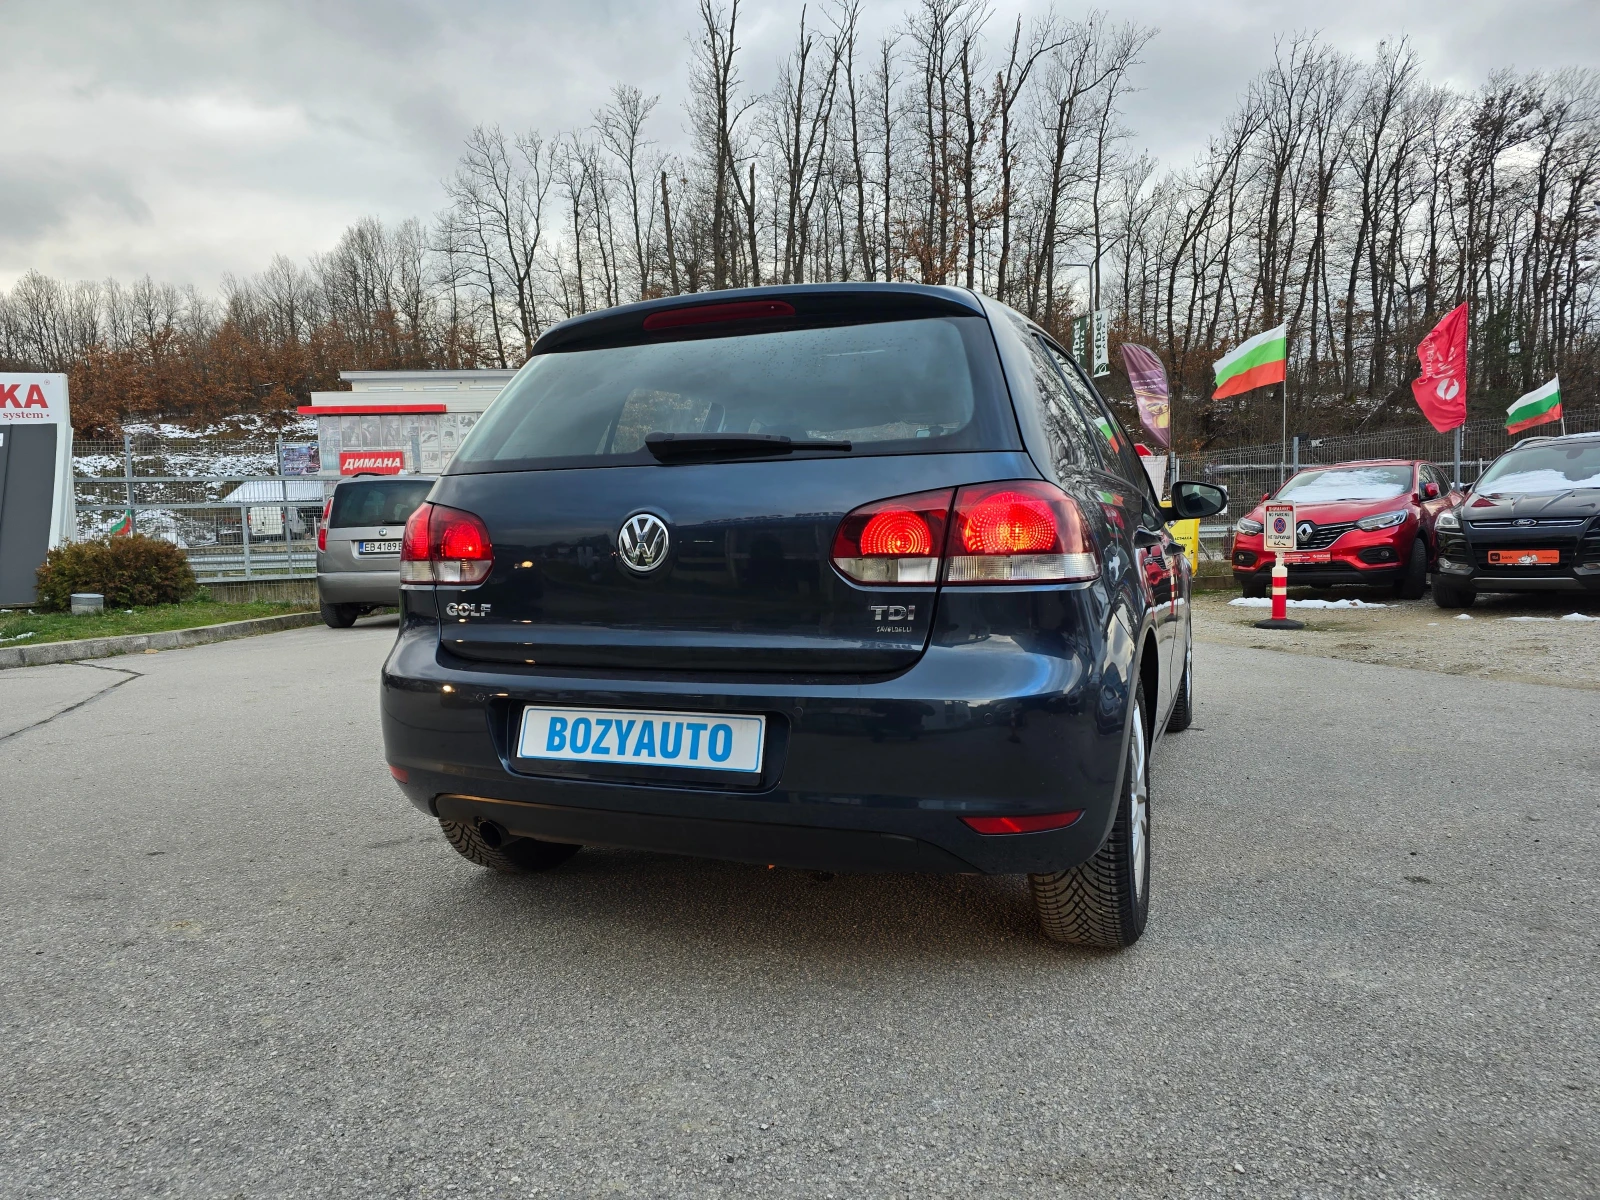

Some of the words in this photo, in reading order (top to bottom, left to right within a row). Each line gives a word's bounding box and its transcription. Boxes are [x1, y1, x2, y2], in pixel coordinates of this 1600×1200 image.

[1094, 313, 1103, 360] efbet
[2, 411, 44, 421] system
[342, 458, 401, 471] ДИМАНА
[376, 542, 398, 552] 4189
[446, 602, 492, 617] GOLF
[870, 605, 916, 621] TDI
[546, 716, 733, 763] BOZYAUTO
